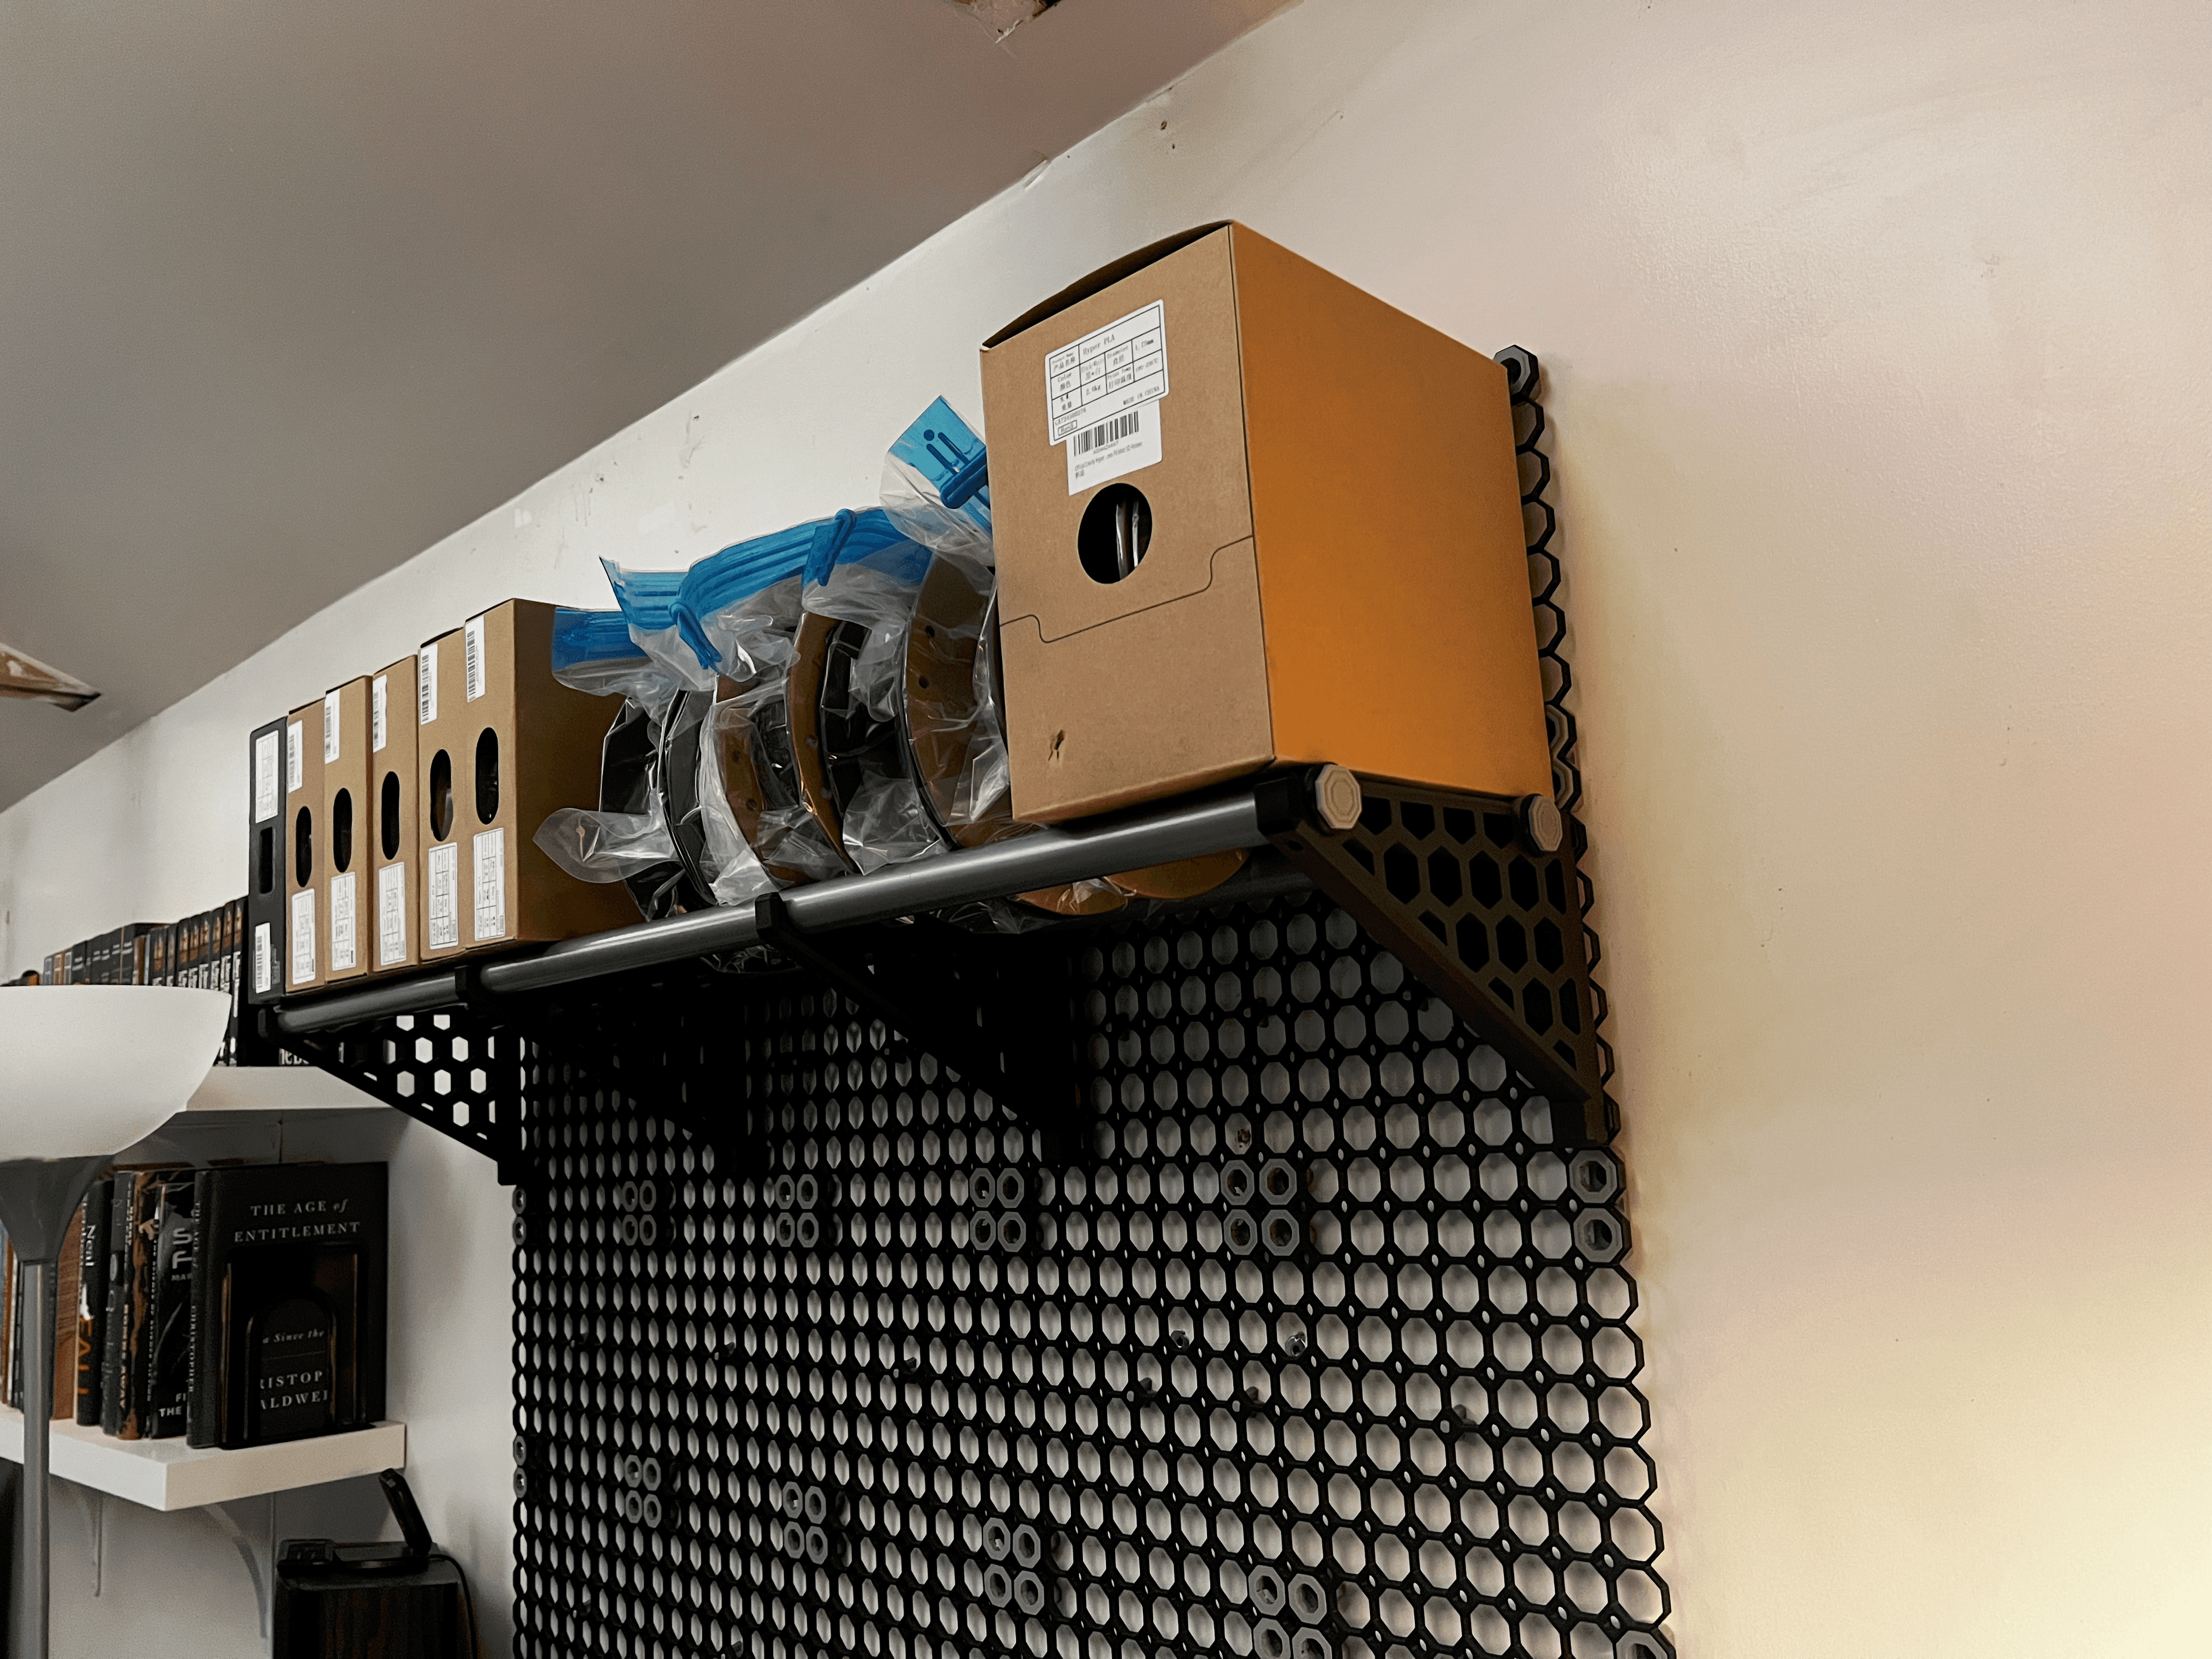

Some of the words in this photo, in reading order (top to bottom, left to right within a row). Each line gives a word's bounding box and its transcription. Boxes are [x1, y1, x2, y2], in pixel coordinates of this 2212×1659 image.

[1083, 343, 1101, 355] Hyper
[1104, 334, 1115, 345] PLA
[1058, 372, 1072, 382] Color
[250, 1203, 287, 1217] THE
[293, 1200, 328, 1214] AGE
[332, 1198, 350, 1214] of
[234, 1221, 361, 1243] ENTITLEMENT
[273, 1332, 305, 1343] Since
[308, 1328, 325, 1339] the
